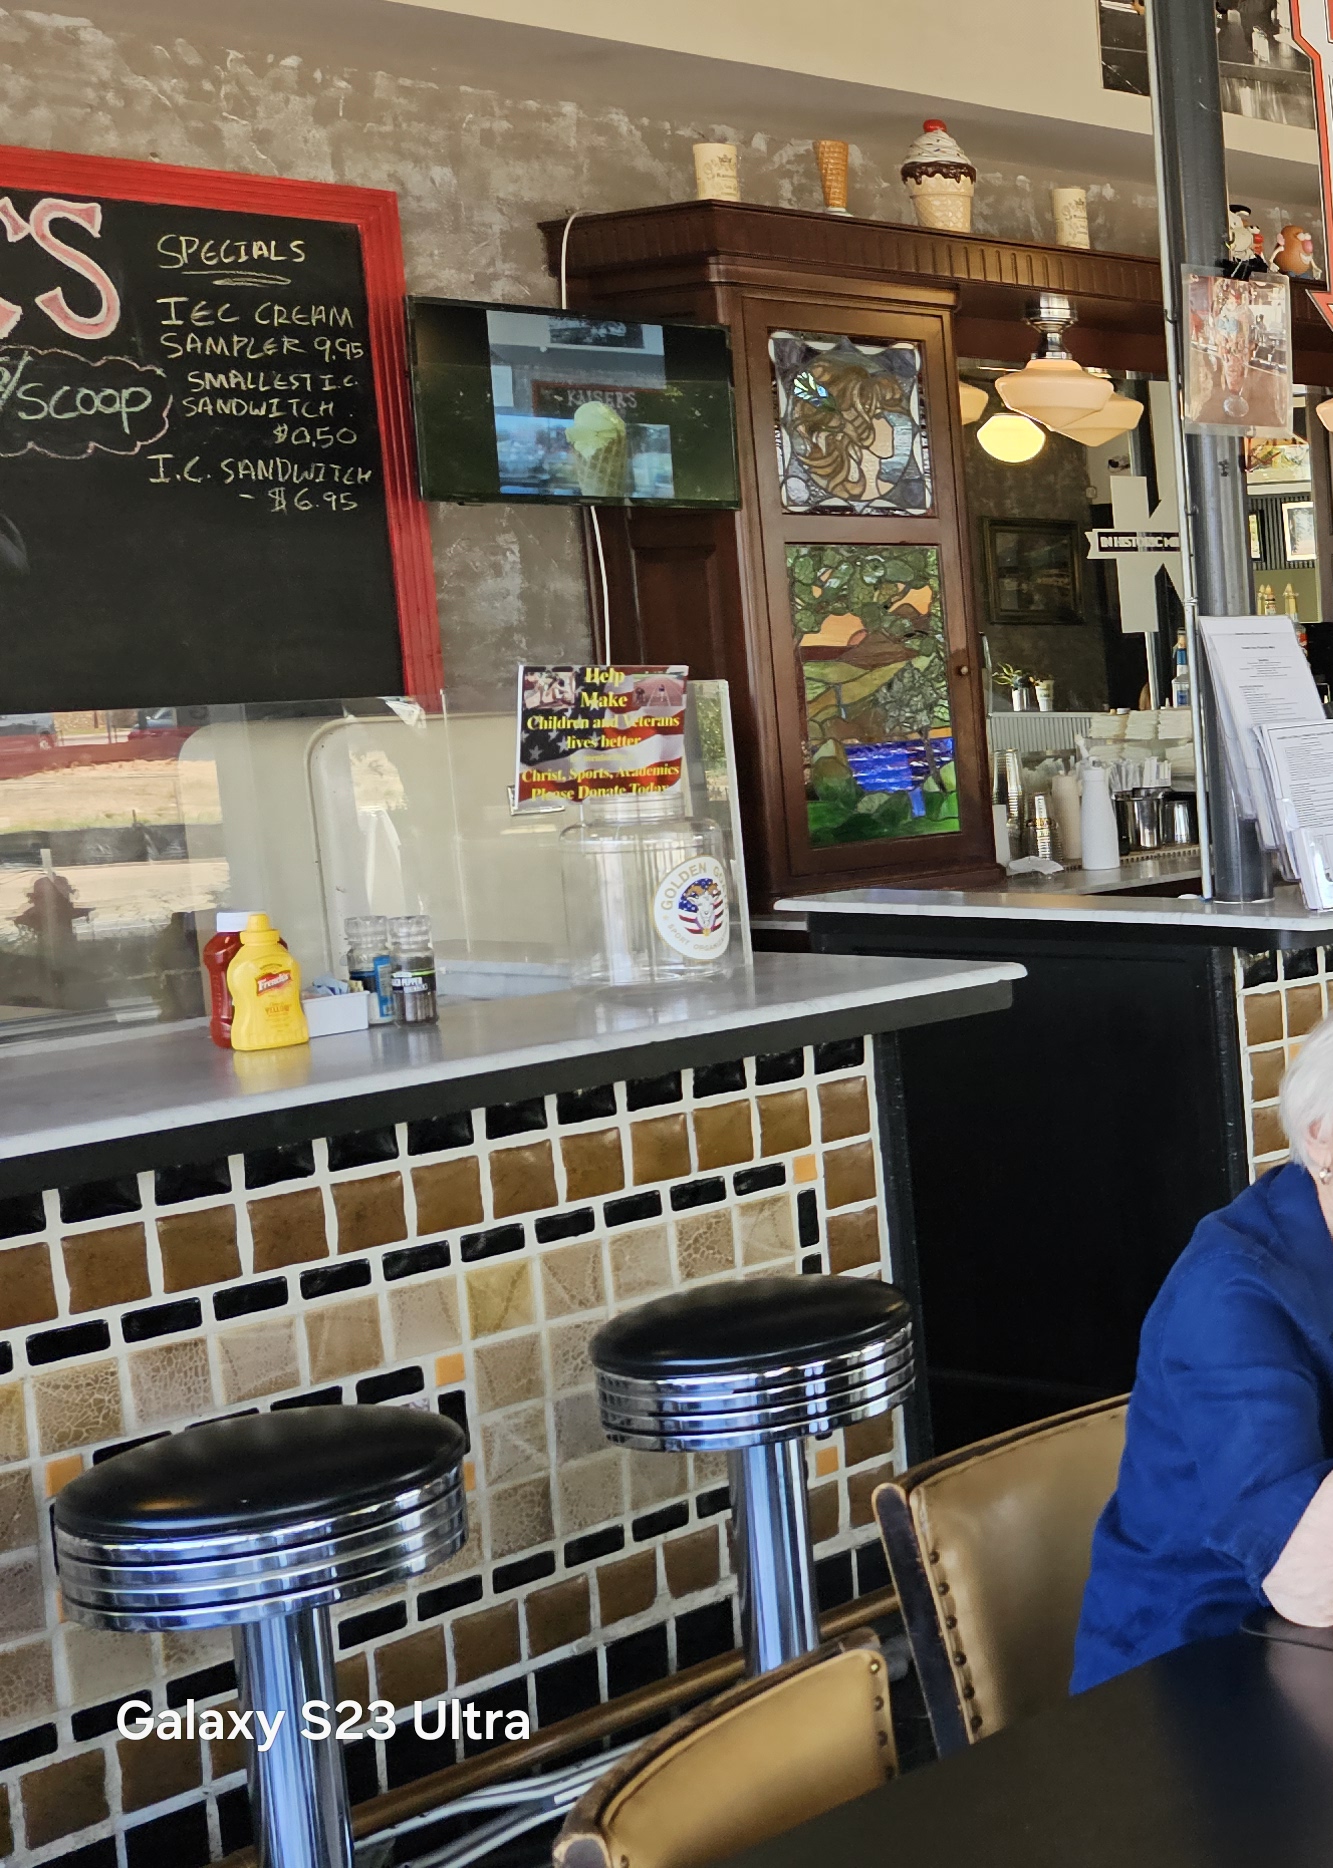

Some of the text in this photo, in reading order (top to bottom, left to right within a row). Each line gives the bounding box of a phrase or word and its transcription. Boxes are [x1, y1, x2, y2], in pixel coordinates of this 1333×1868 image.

[157, 234, 306, 269] SPECIALS
[254, 302, 354, 328] CREAM
[160, 332, 365, 362] SAMPLER 9.95
[187, 370, 313, 393] SMALLEST
[182, 397, 335, 418] SANDWITCH
[220, 457, 373, 486] SANDWITCH
[267, 487, 359, 515] $6.95
[584, 667, 626, 687] Help
[580, 691, 628, 708] Make
[526, 712, 681, 731] Children and Veterans
[566, 733, 642, 750] lives better
[521, 764, 681, 786] Christ, Sports, Academics
[531, 787, 575, 802] Please
[577, 784, 627, 800] Donate
[660, 862, 708, 911] GOLDEN
